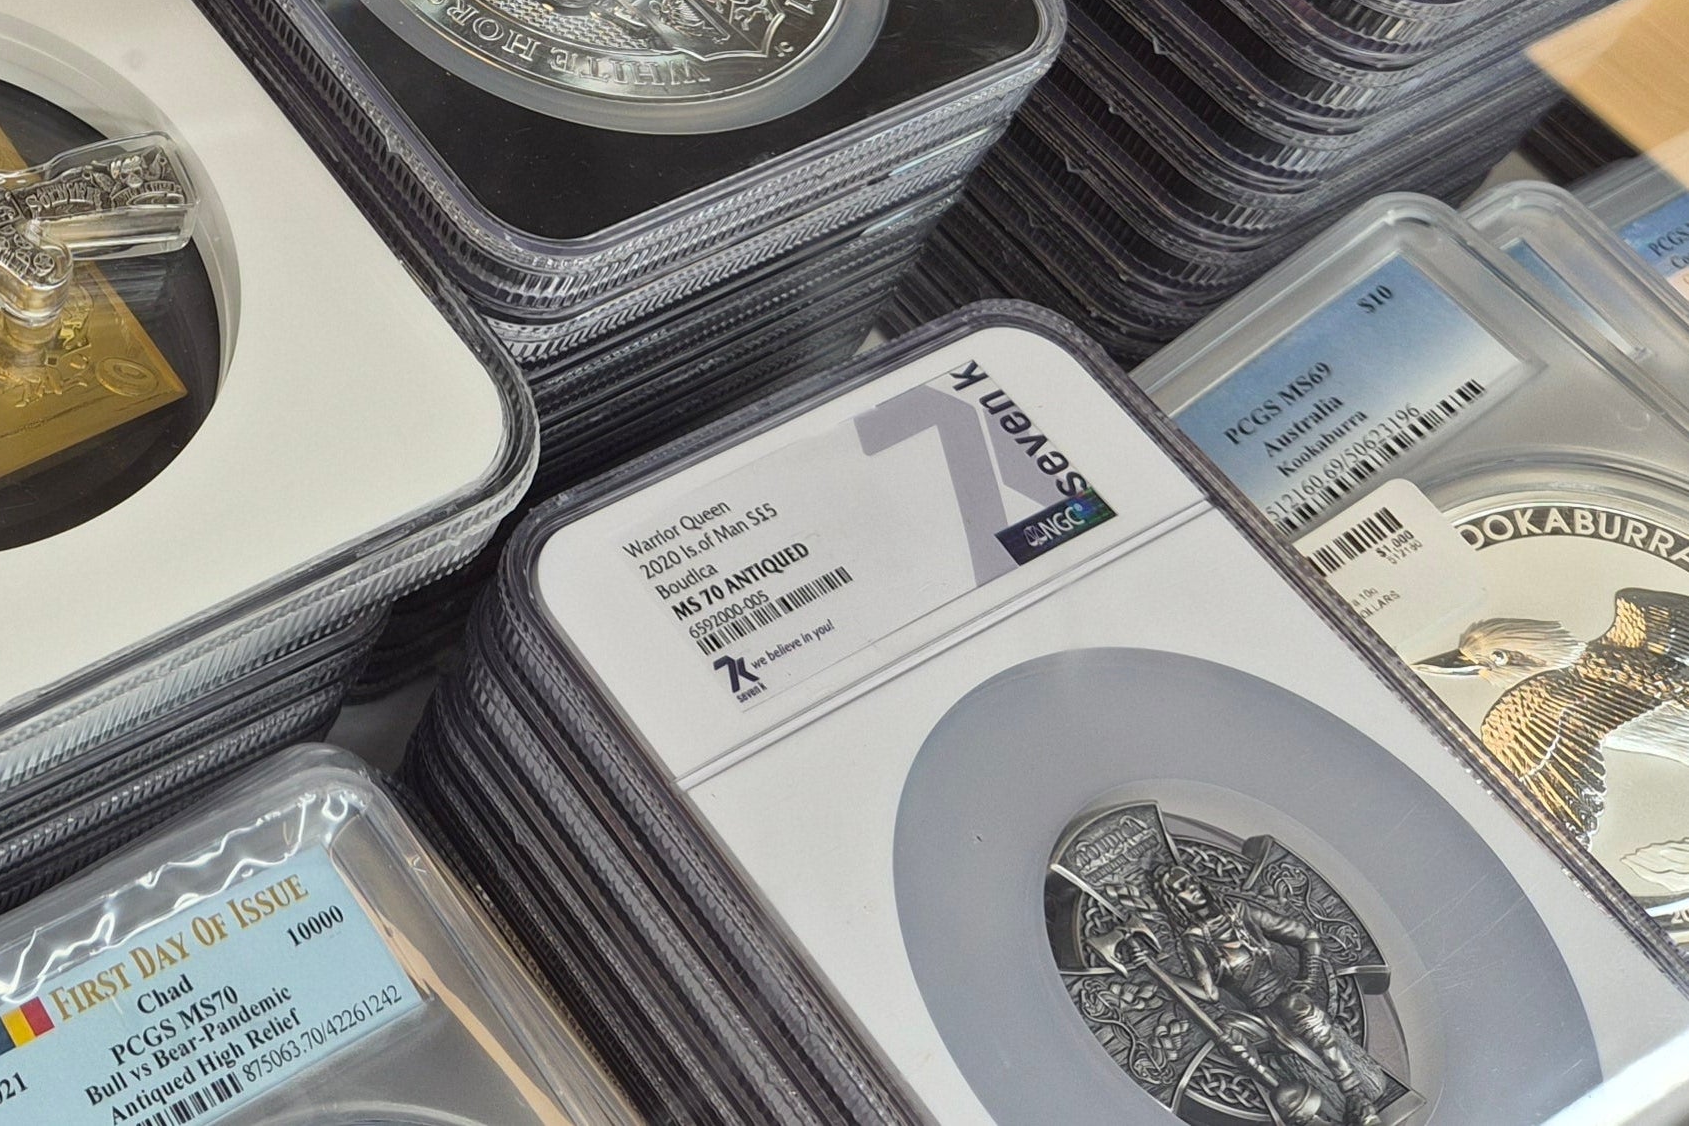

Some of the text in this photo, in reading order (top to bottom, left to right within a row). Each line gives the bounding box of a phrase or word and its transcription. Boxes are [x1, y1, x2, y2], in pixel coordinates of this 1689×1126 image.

[1225, 361, 1333, 446] PCGS MS69
[1262, 395, 1345, 458] Australia
[978, 387, 1089, 499] seven
[1276, 409, 1369, 478] Kookaburra
[622, 501, 732, 558] Warrior Queen
[639, 549, 682, 579] 2020
[713, 519, 749, 542] Man
[1457, 508, 1689, 564] OOKABURRA
[655, 562, 719, 600] Boudica
[671, 542, 810, 621] MS 70 ANTIQUED
[688, 590, 770, 640] 6592000-005
[751, 618, 835, 670] we believe in you!
[736, 686, 760, 704] seven
[287, 904, 345, 948] 10000
[110, 985, 239, 1066] PCGS MS70
[137, 974, 194, 1016] Chad
[84, 984, 292, 1107] Bull vs Bear-Pandemic
[244, 984, 403, 1082] 875063.70/42261242
[111, 1008, 301, 1126] Antiqued High Relief
